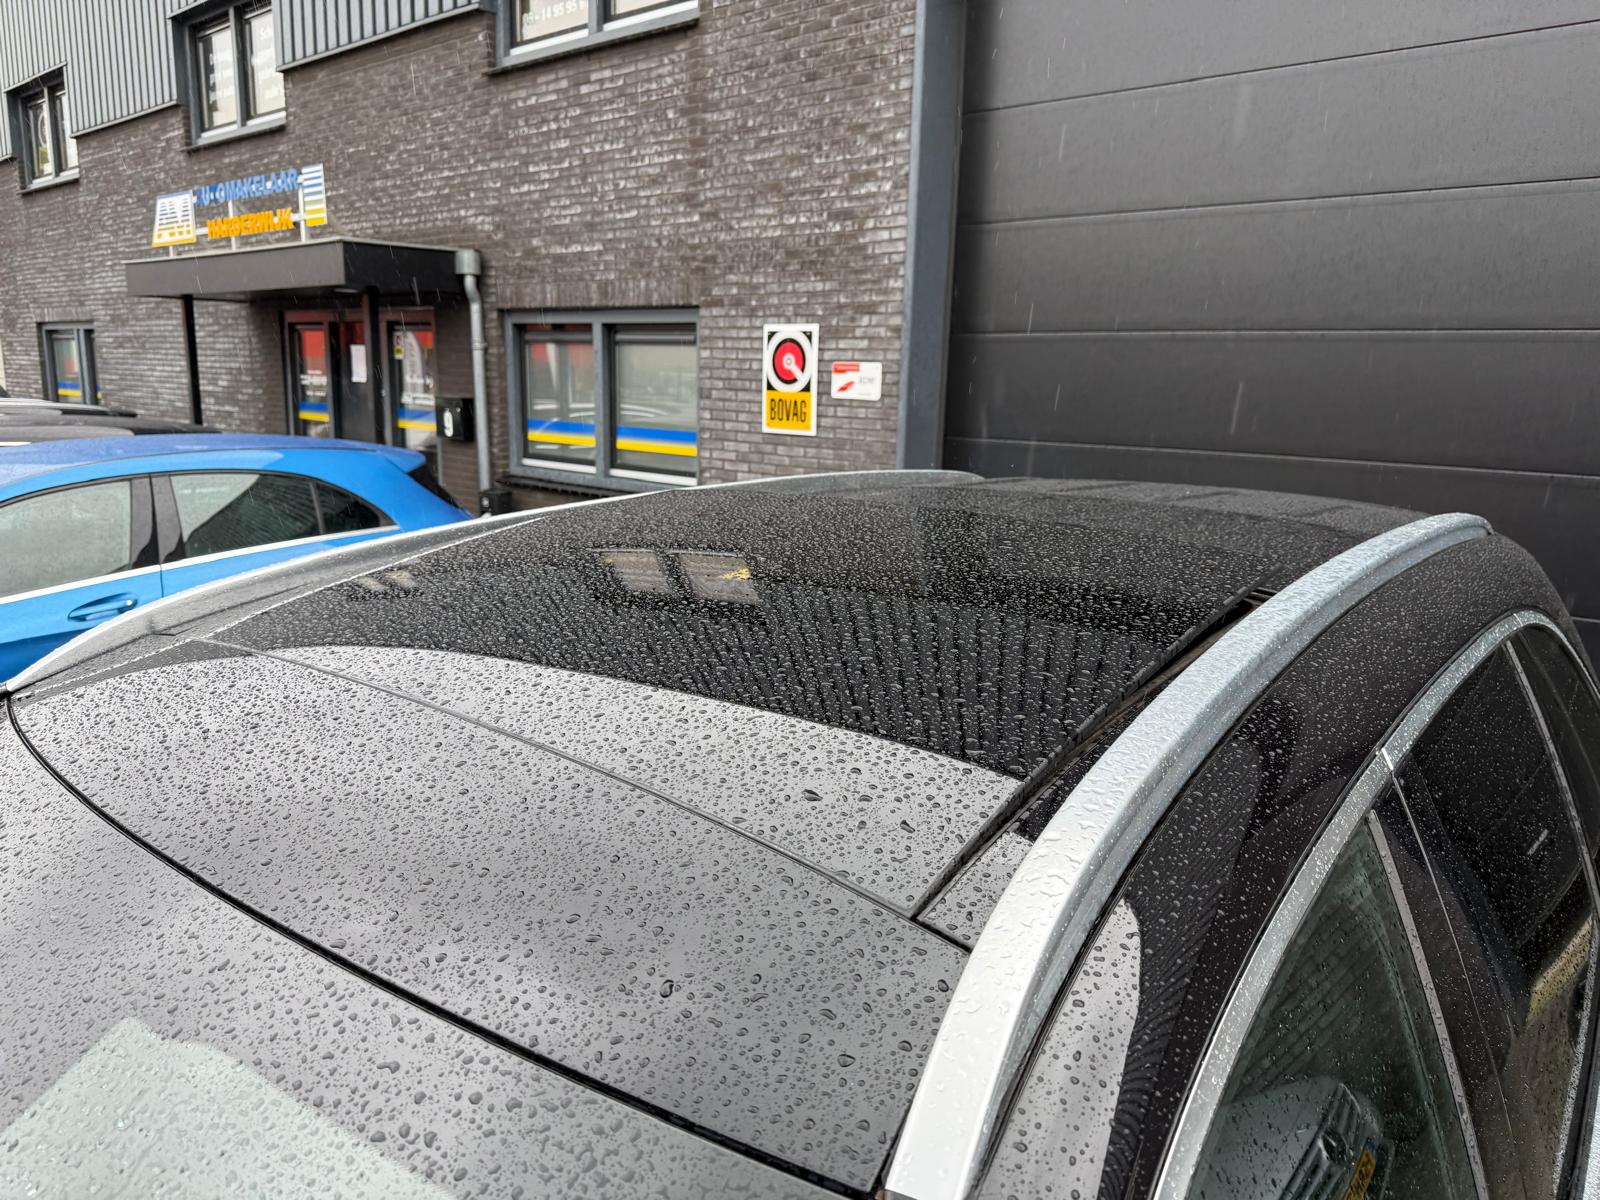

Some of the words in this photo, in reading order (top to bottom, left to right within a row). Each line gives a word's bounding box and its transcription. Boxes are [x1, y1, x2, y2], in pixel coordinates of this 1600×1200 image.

[207, 208, 295, 239] HARDERWIJK
[443, 410, 454, 437] 9
[770, 398, 806, 422] BOVAG
